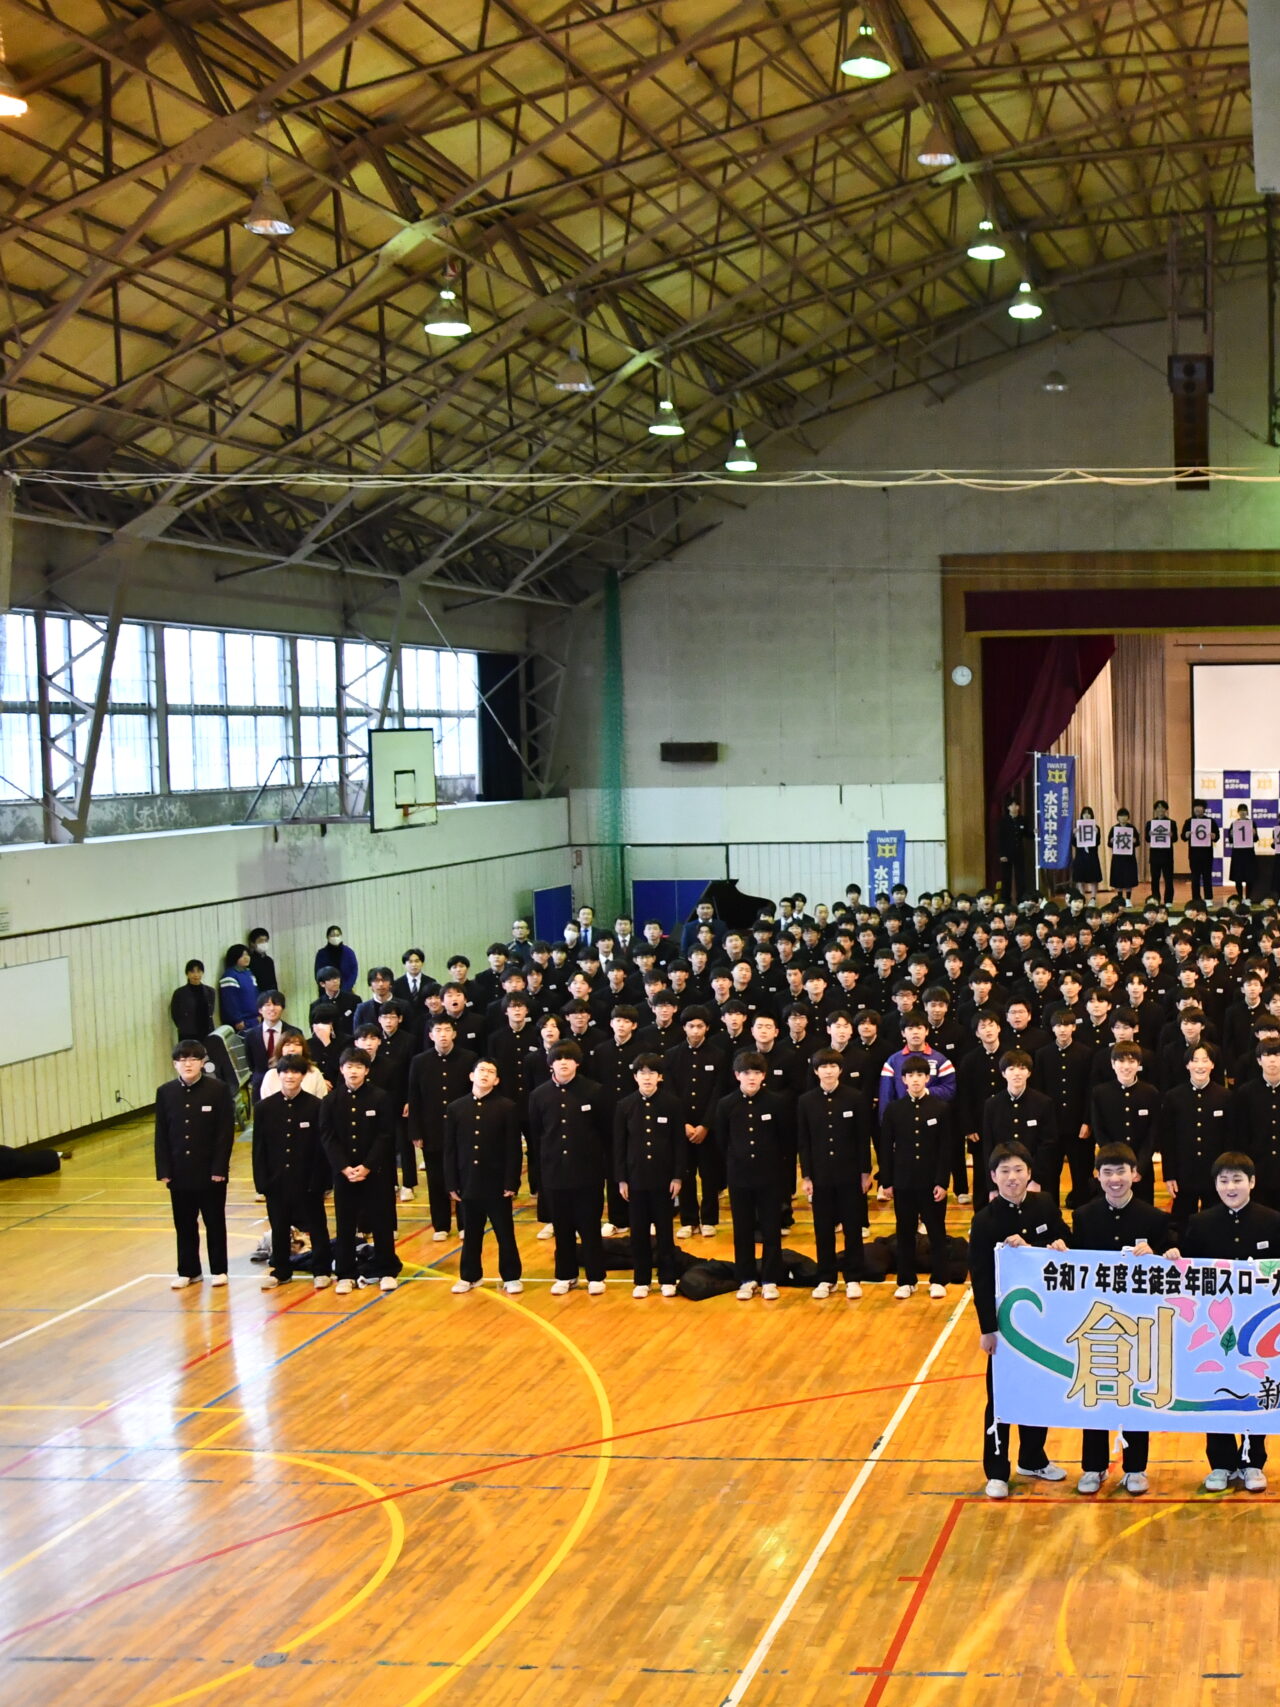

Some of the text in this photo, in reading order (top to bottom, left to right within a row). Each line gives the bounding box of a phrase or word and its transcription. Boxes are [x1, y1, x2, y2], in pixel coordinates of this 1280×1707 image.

[1043, 790, 1059, 863] 水沢中学校
[1066, 1301, 1175, 1408] 創
